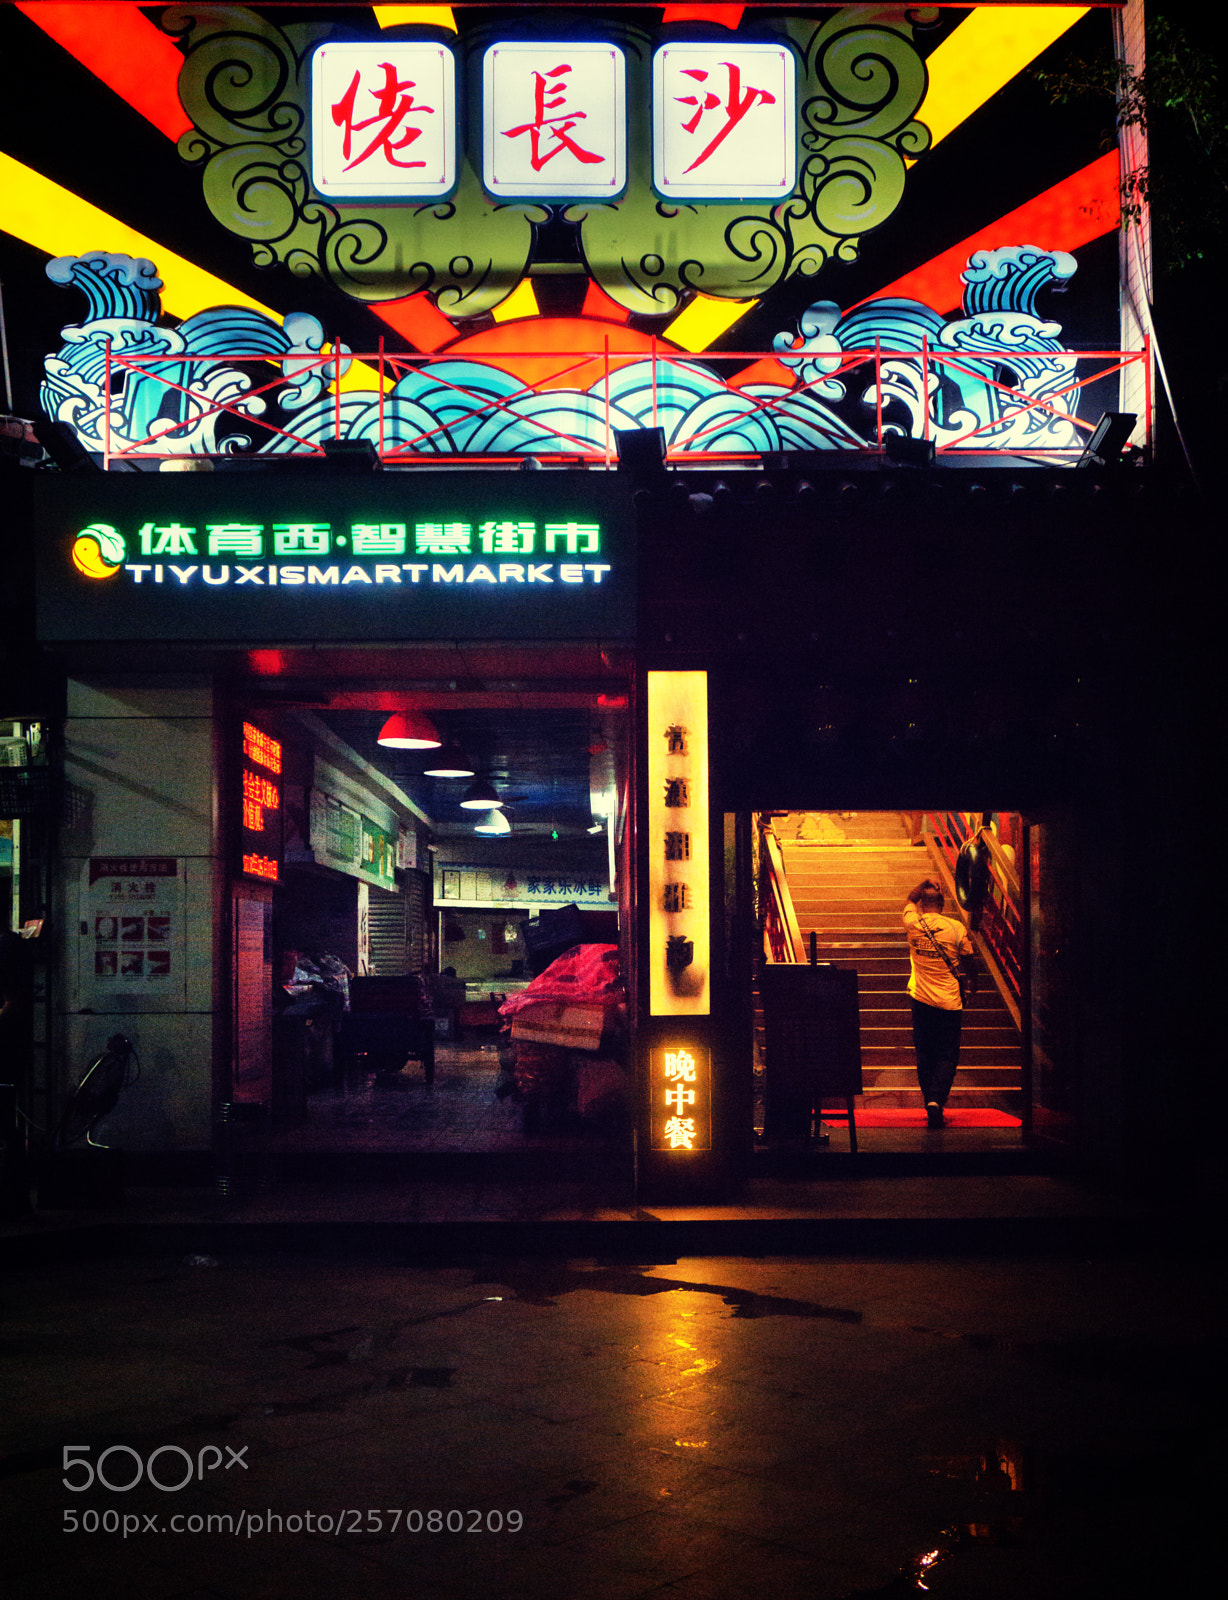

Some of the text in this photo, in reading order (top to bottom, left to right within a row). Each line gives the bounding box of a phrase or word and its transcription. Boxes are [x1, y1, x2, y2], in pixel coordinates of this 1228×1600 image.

[138, 522, 600, 557] 体育西·智慧街市
[664, 1050, 697, 1149] 晚中餐
